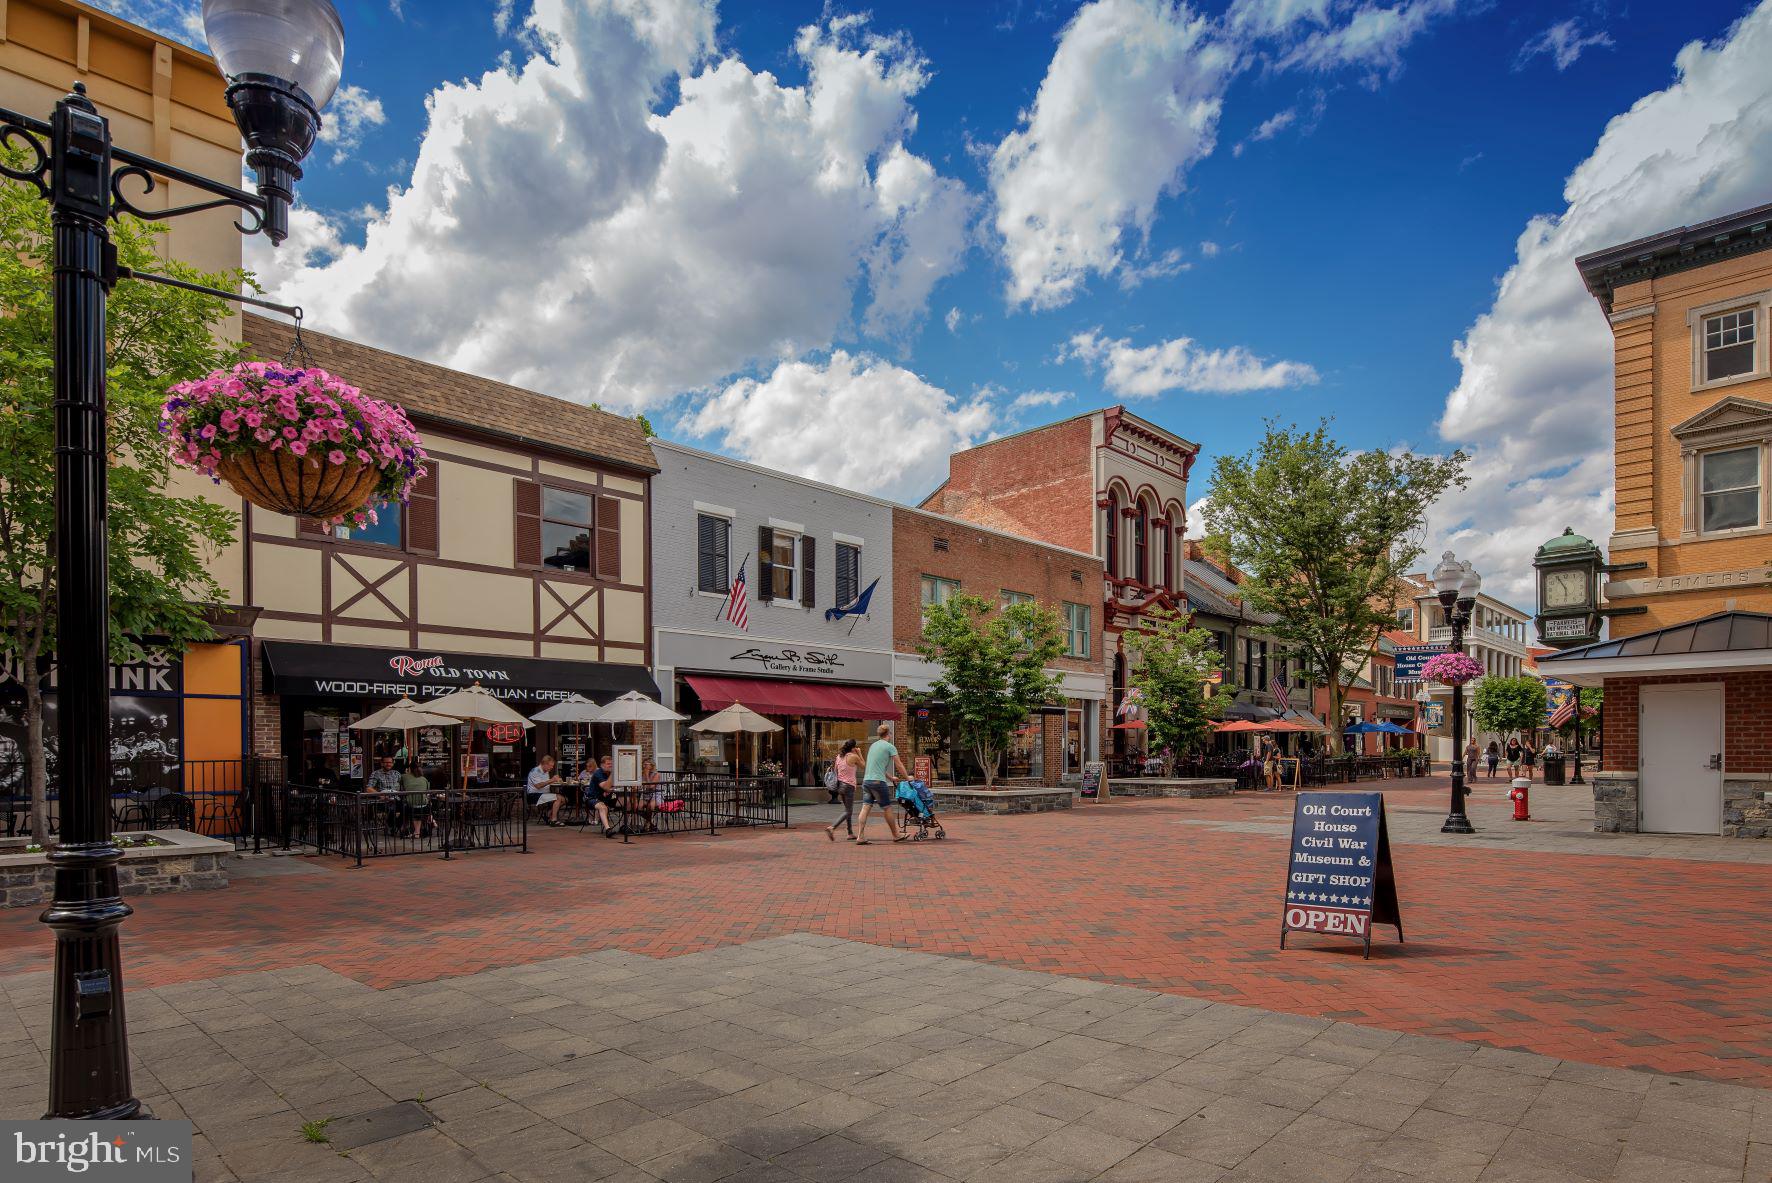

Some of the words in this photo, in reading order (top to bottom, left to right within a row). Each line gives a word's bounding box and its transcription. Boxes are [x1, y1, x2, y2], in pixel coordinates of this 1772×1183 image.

[1642, 571, 1748, 590] FARMERS
[390, 655, 445, 677] Roma
[770, 663, 791, 673] Gallery
[799, 665, 816, 673] Frame
[429, 667, 461, 678] OLD
[463, 668, 511, 681] TOWN
[315, 680, 417, 696] WOOD-FIRED
[488, 723, 521, 742] OPEN
[1302, 804, 1326, 816] Old
[1330, 805, 1372, 817] Court
[1313, 821, 1358, 833] House
[1301, 836, 1333, 848] Civil
[1338, 838, 1368, 850] War
[1294, 852, 1354, 866] Museum
[1358, 855, 1371, 867] &
[1291, 872, 1326, 885] GIFT
[1329, 874, 1371, 887] SHOP
[1286, 908, 1369, 934] OPEN
